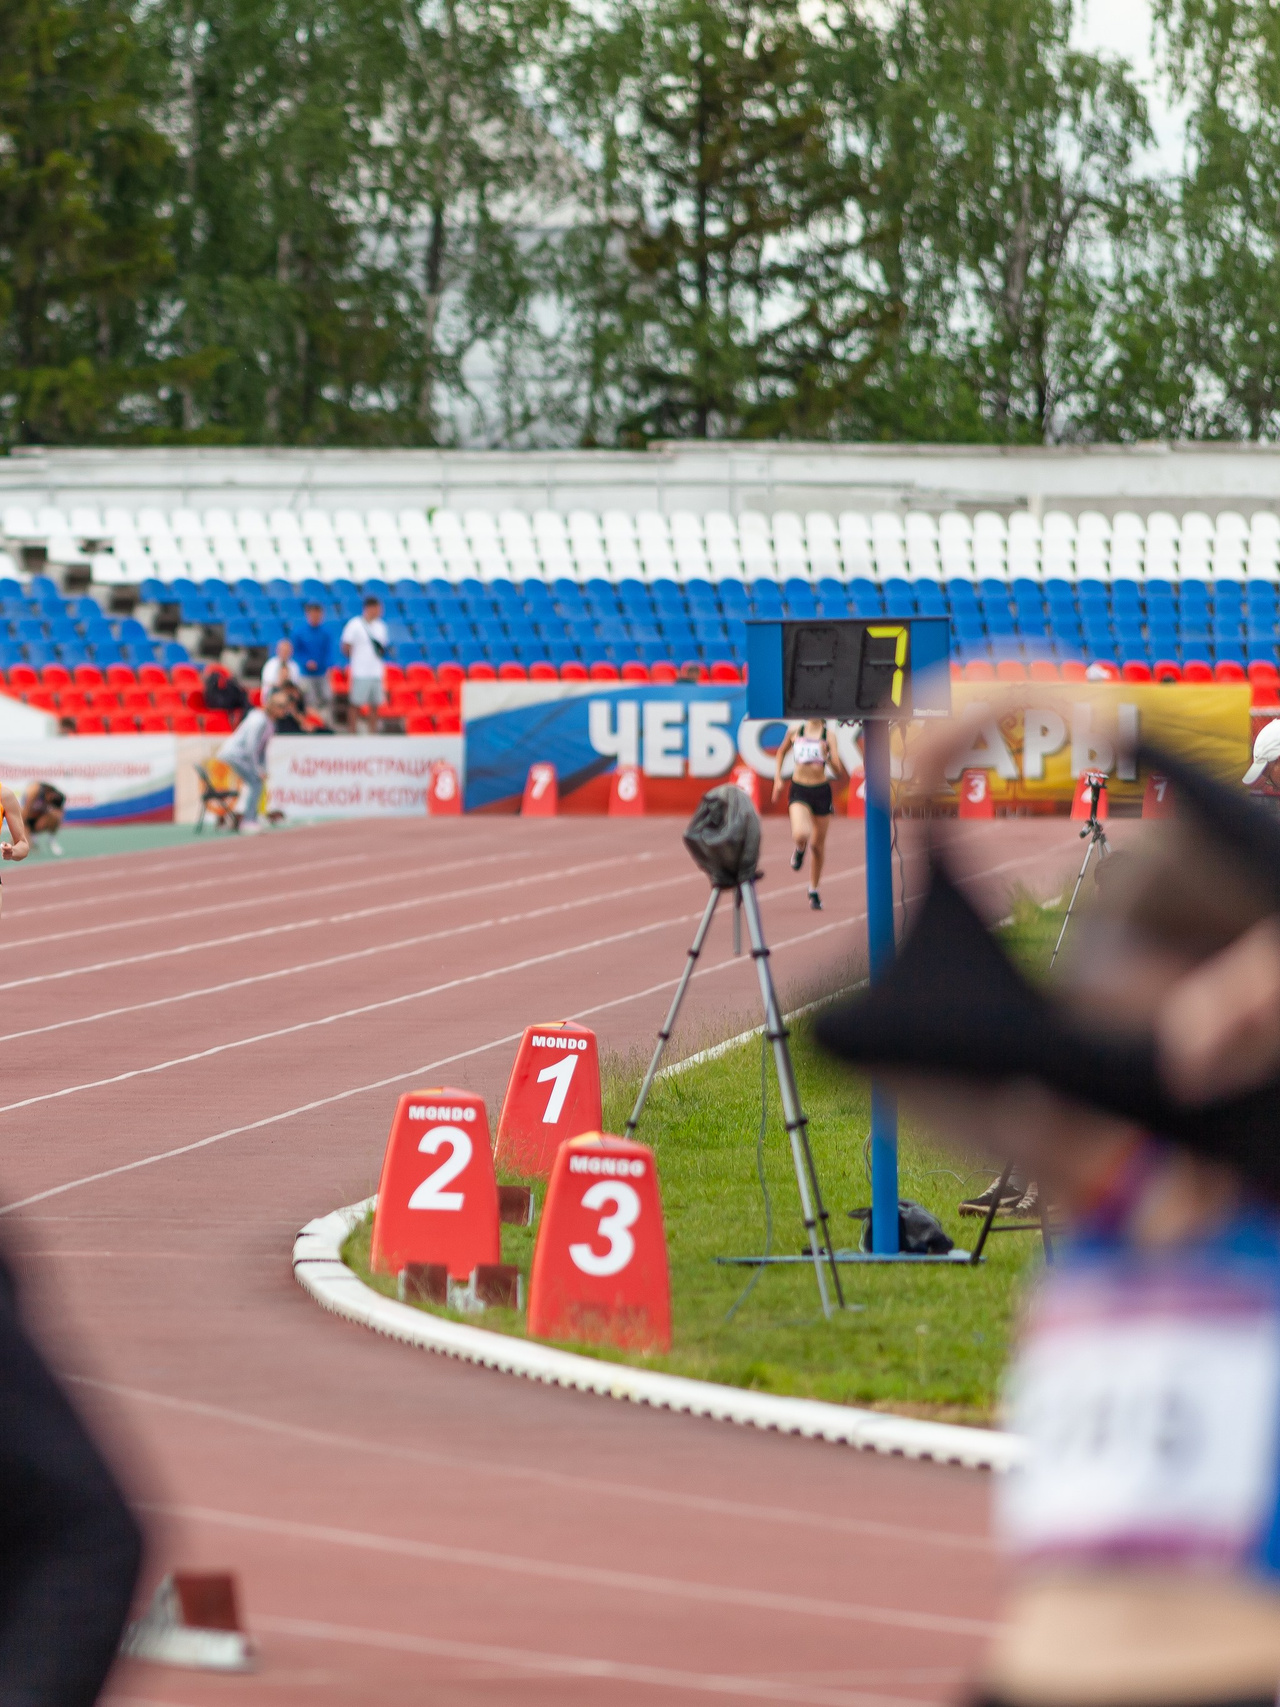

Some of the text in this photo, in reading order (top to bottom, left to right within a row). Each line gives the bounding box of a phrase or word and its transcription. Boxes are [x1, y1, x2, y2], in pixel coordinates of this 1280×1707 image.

[866, 625, 908, 708] 7
[587, 700, 1138, 781] ЧЕБОКАРЫ
[288, 757, 445, 777] АДМИНИСТРАЦИ
[530, 768, 552, 800] 7
[617, 770, 638, 801] 6
[967, 775, 987, 803] 3
[531, 1035, 588, 1051] MONDO
[536, 1053, 579, 1124] 1
[408, 1105, 477, 1123] MONDO
[407, 1125, 473, 1212] 2
[569, 1154, 647, 1178] MONDO
[568, 1179, 642, 1277] 3
